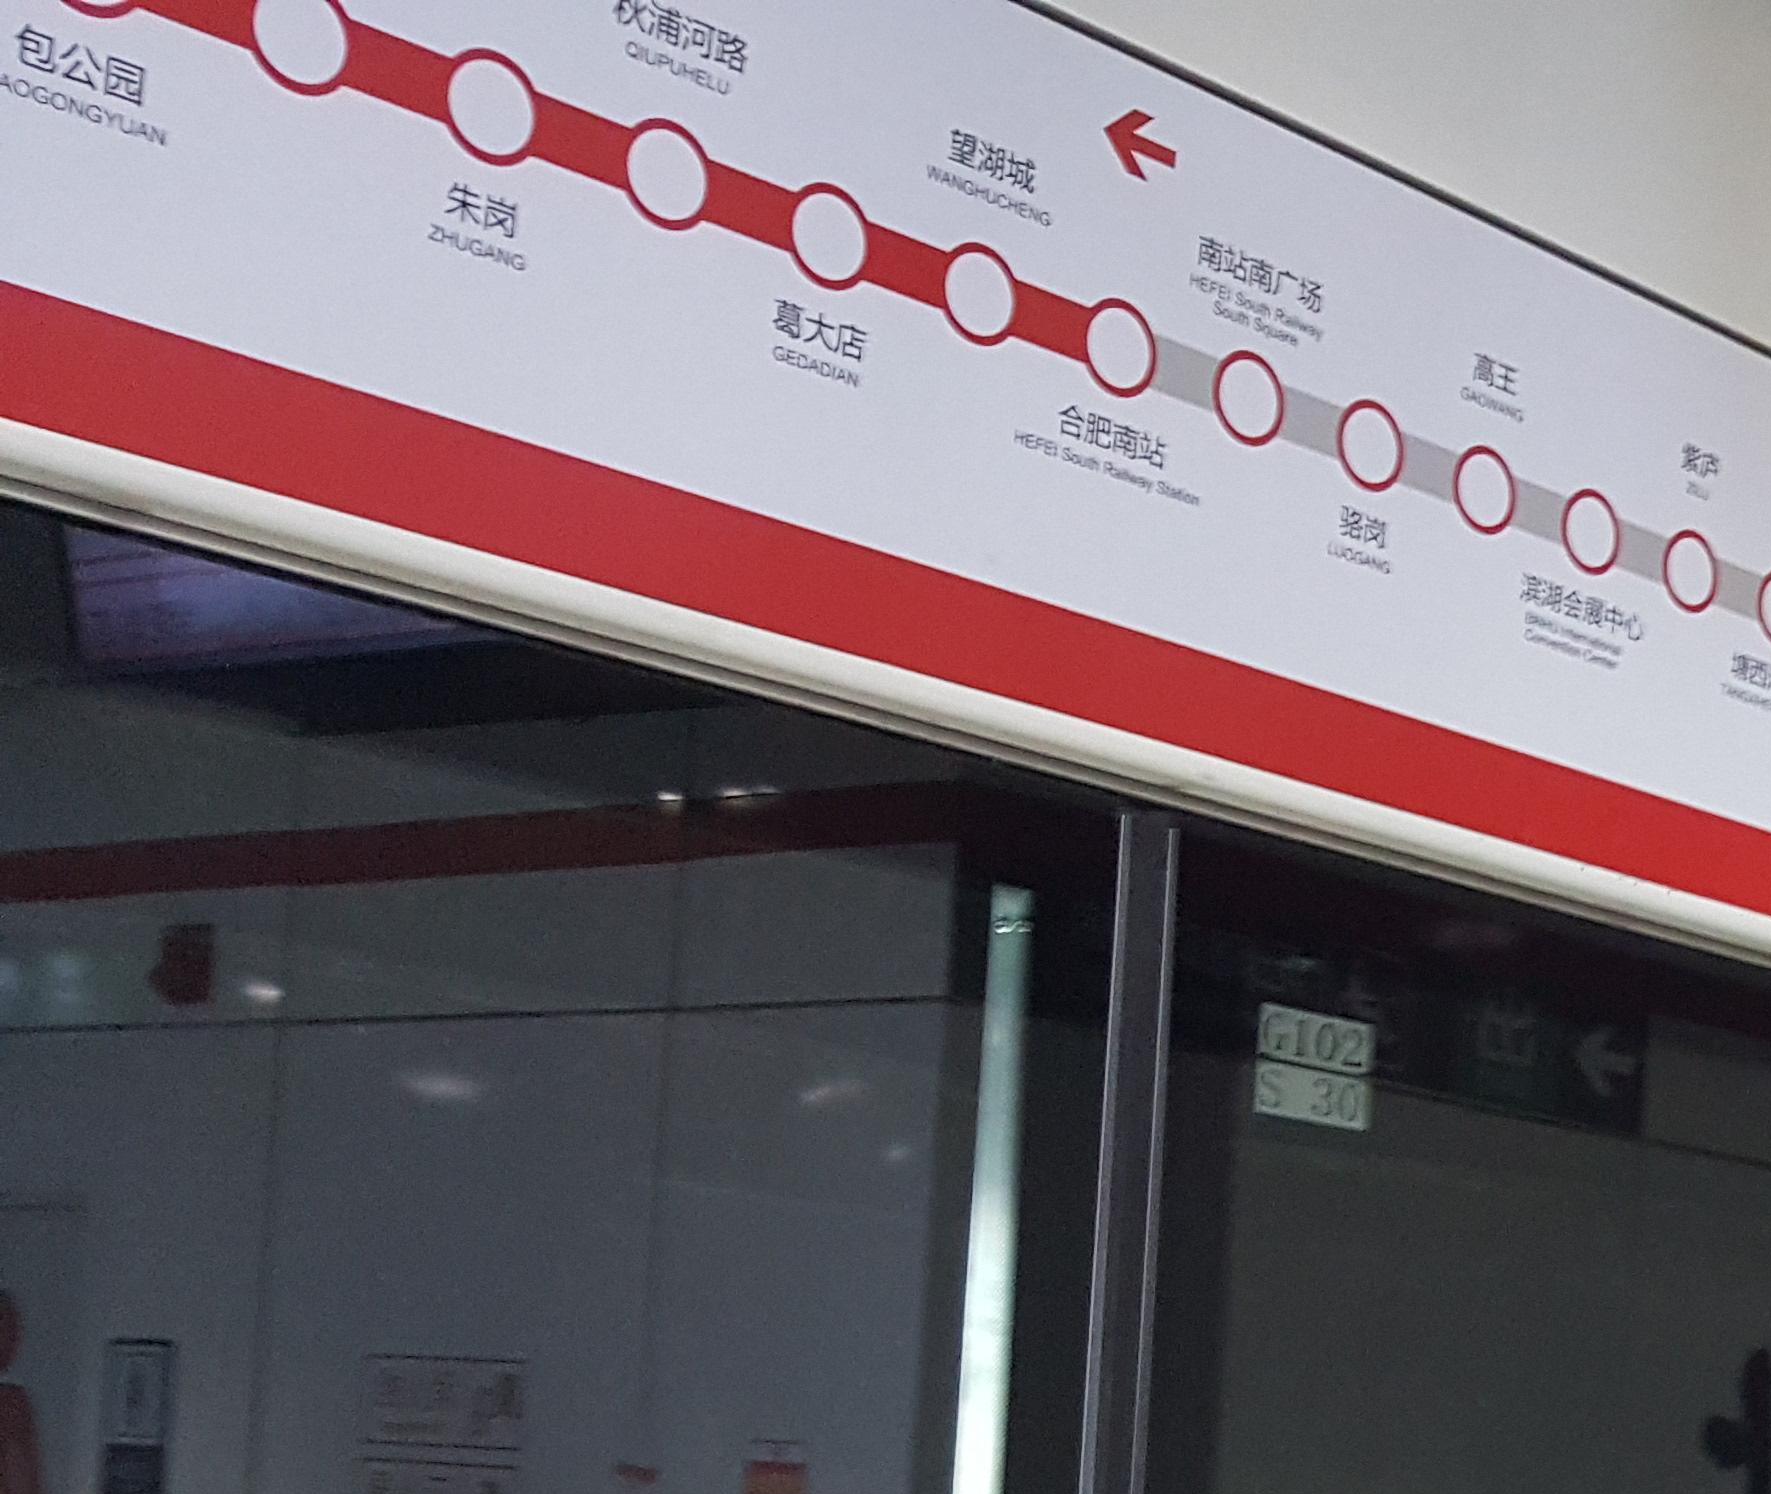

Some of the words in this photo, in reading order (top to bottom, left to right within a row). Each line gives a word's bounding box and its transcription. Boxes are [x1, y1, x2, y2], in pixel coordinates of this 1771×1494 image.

[16, 24, 146, 106] 包公园
[613, 0, 748, 73] 秋浦河路
[624, 41, 730, 95] QIUPUHELU
[948, 128, 1037, 194] 望湖城
[444, 182, 518, 239] 朱岗
[926, 164, 1053, 227] WANGHUCHENG
[427, 223, 528, 271] ZHUGANG
[1198, 235, 1323, 314] 南站南广场
[772, 299, 868, 362] 葛大店
[772, 345, 861, 388] GEDADIAN
[1473, 352, 1520, 397] 高王
[1013, 429, 1058, 457] HEFEI
[1057, 404, 1168, 470] 合肥南站
[1340, 505, 1387, 549] 骆岗
[1519, 572, 1645, 642] 滨湖会展中心
[1262, 1012, 1363, 1068] G102
[1258, 1069, 1281, 1108] S
[1310, 1078, 1359, 1122] 30
